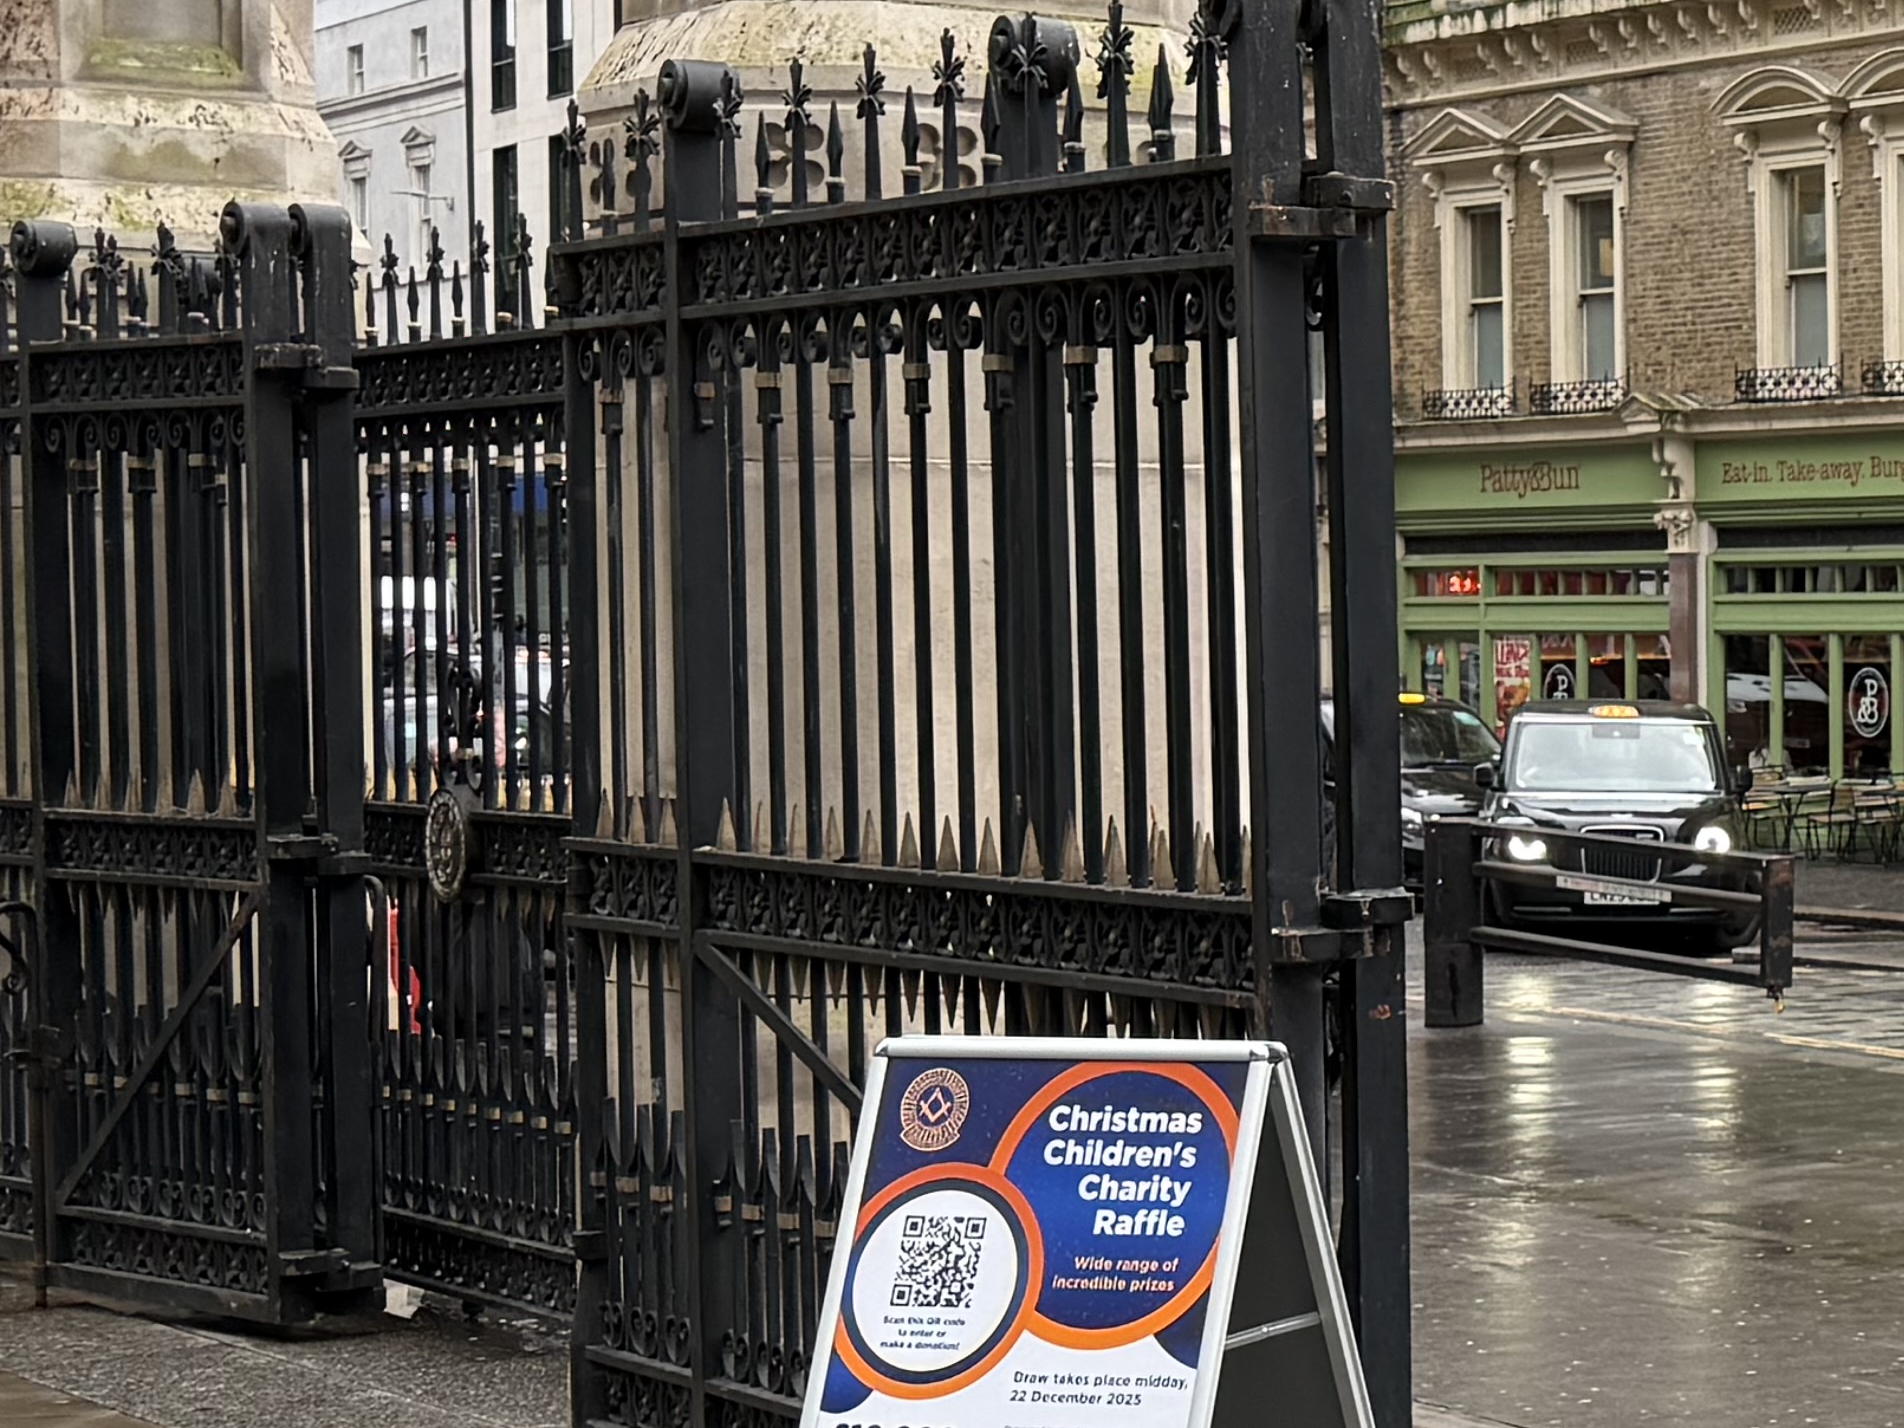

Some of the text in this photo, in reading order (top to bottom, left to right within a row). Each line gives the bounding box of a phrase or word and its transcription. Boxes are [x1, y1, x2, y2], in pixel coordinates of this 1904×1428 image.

[1049, 1105, 1202, 1134] Christmas
[1044, 1139, 1197, 1168] Children's
[1078, 1174, 1192, 1207] Charity
[1093, 1209, 1185, 1237] Raffle
[1074, 1256, 1179, 1274] Wide range of
[1052, 1276, 1175, 1292] incredible prizes
[1014, 1371, 1188, 1390] Draw takes place midday,
[1009, 1390, 1142, 1406] 22 December 2025
